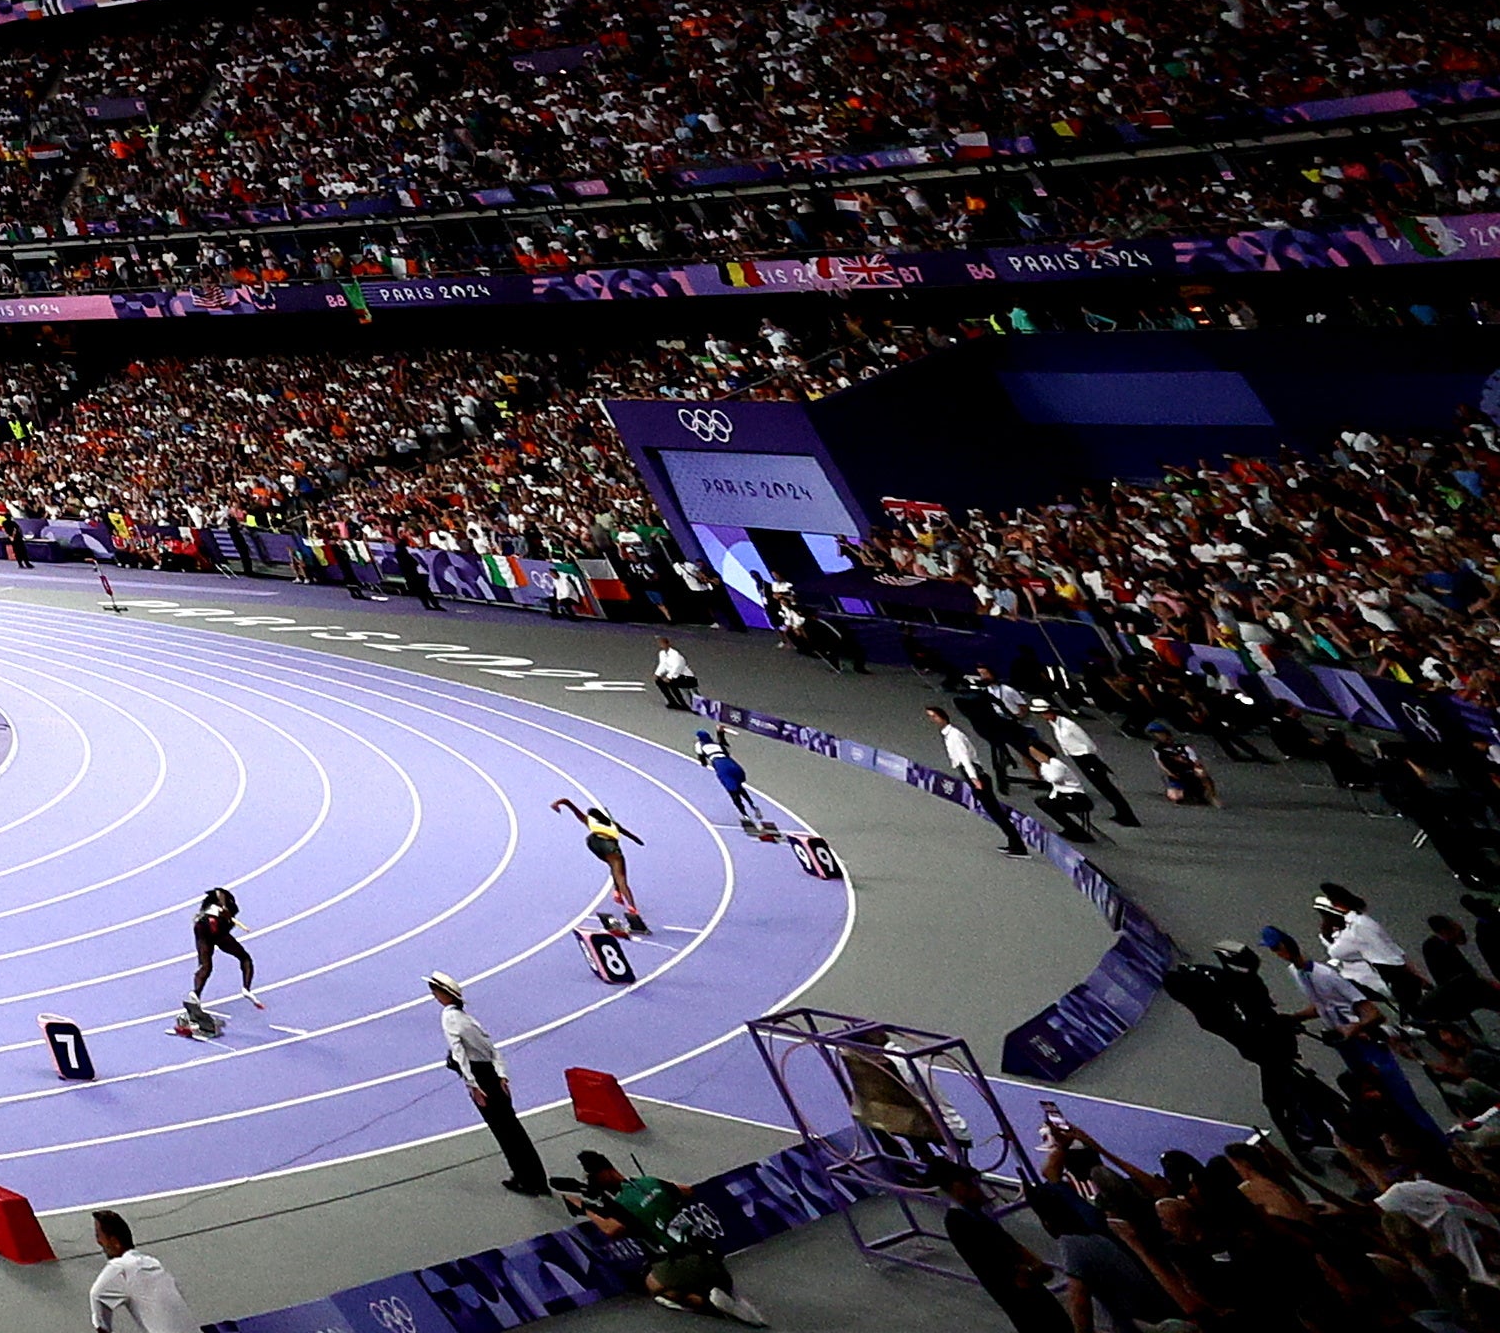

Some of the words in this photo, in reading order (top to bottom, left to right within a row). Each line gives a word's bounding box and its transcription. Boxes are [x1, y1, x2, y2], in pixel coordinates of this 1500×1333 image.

[966, 261, 996, 281] B6
[1008, 253, 1080, 274] PARIS
[900, 266, 924, 284] B7
[379, 287, 434, 302] PARIS
[437, 283, 491, 299] 2024
[18, 301, 60, 316] 2024
[701, 478, 757, 497] PARIS
[759, 481, 813, 501] 2024
[106, 600, 402, 641] PARIS
[362, 642, 647, 693] 2024
[815, 845, 835, 874] 9
[601, 944, 626, 976] 8
[54, 1034, 79, 1069] 7
